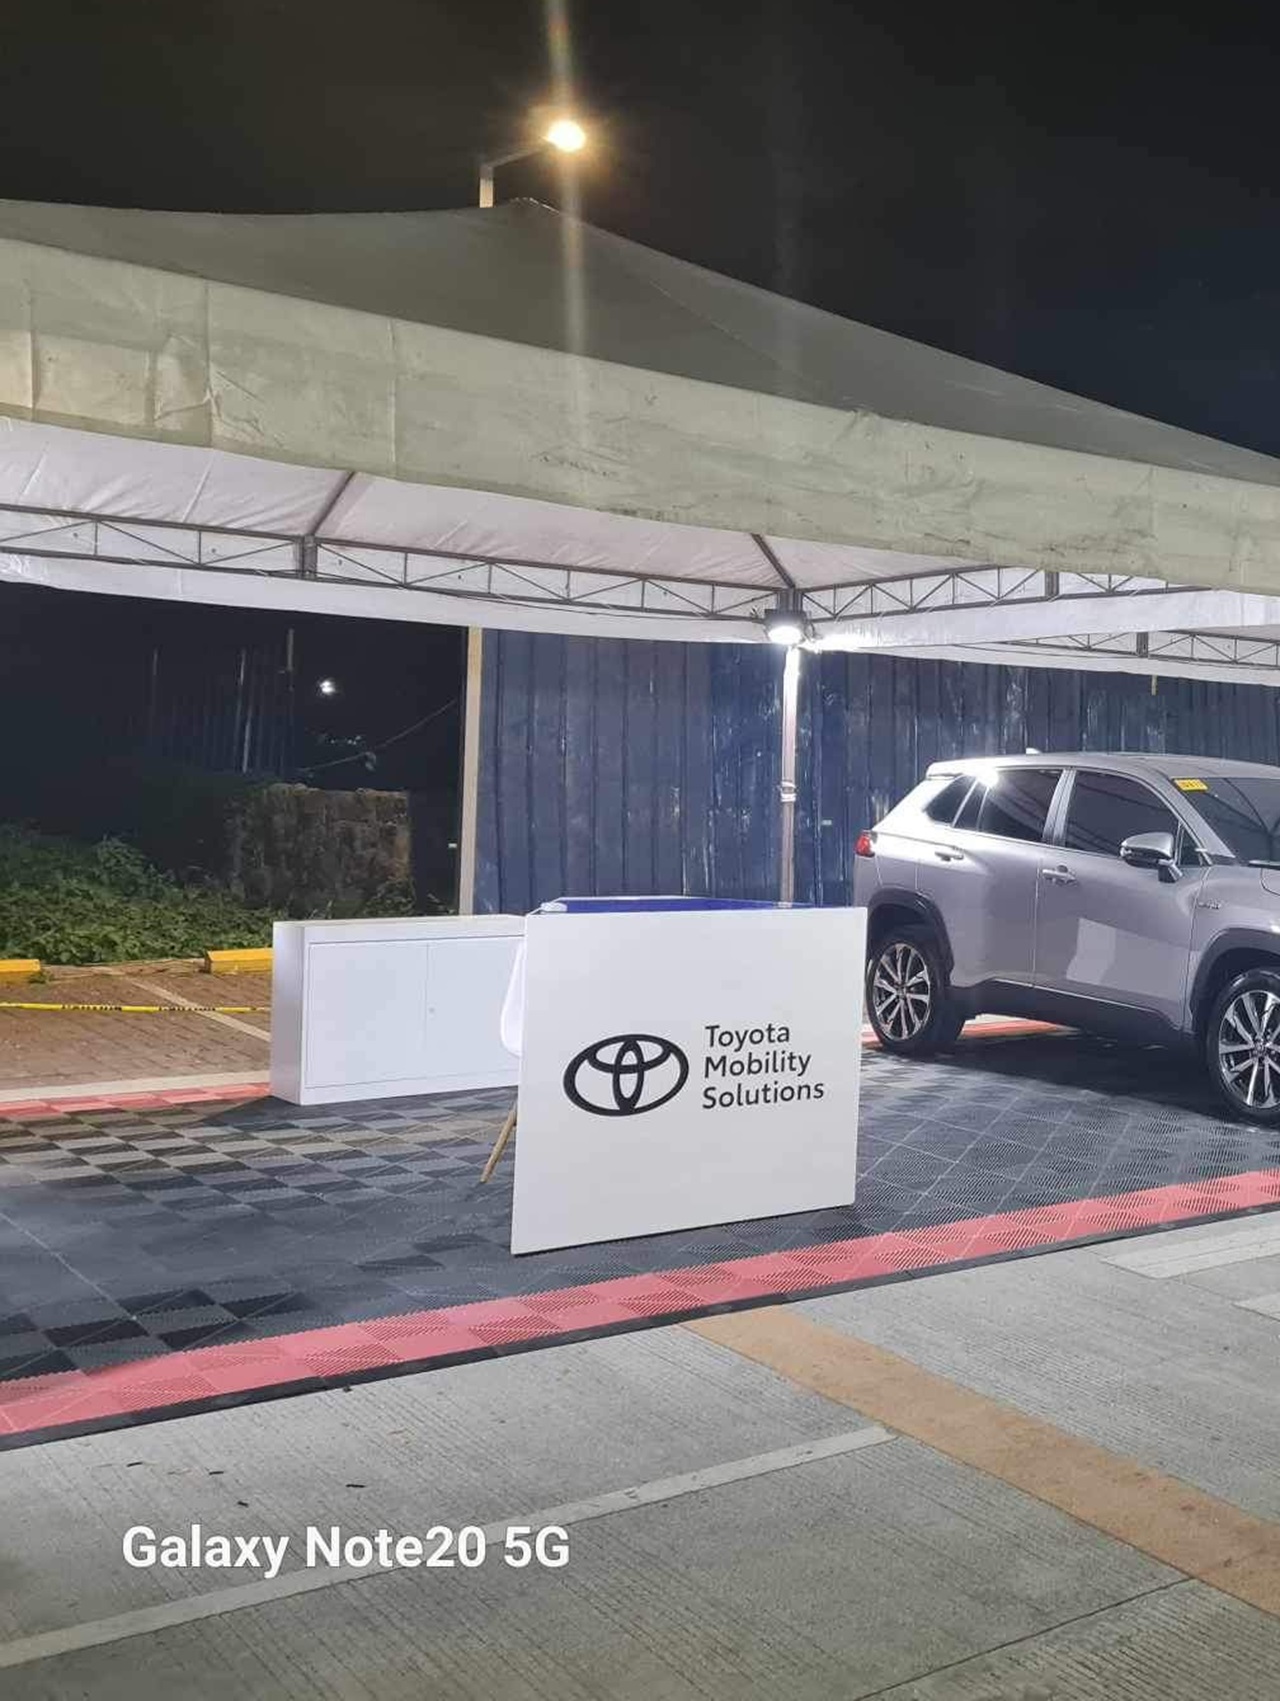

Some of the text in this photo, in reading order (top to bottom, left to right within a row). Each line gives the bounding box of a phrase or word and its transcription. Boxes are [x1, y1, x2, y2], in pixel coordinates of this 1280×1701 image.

[704, 1023, 790, 1052] Toyota
[704, 1050, 811, 1079] Mobility
[702, 1080, 824, 1110] Solutions
